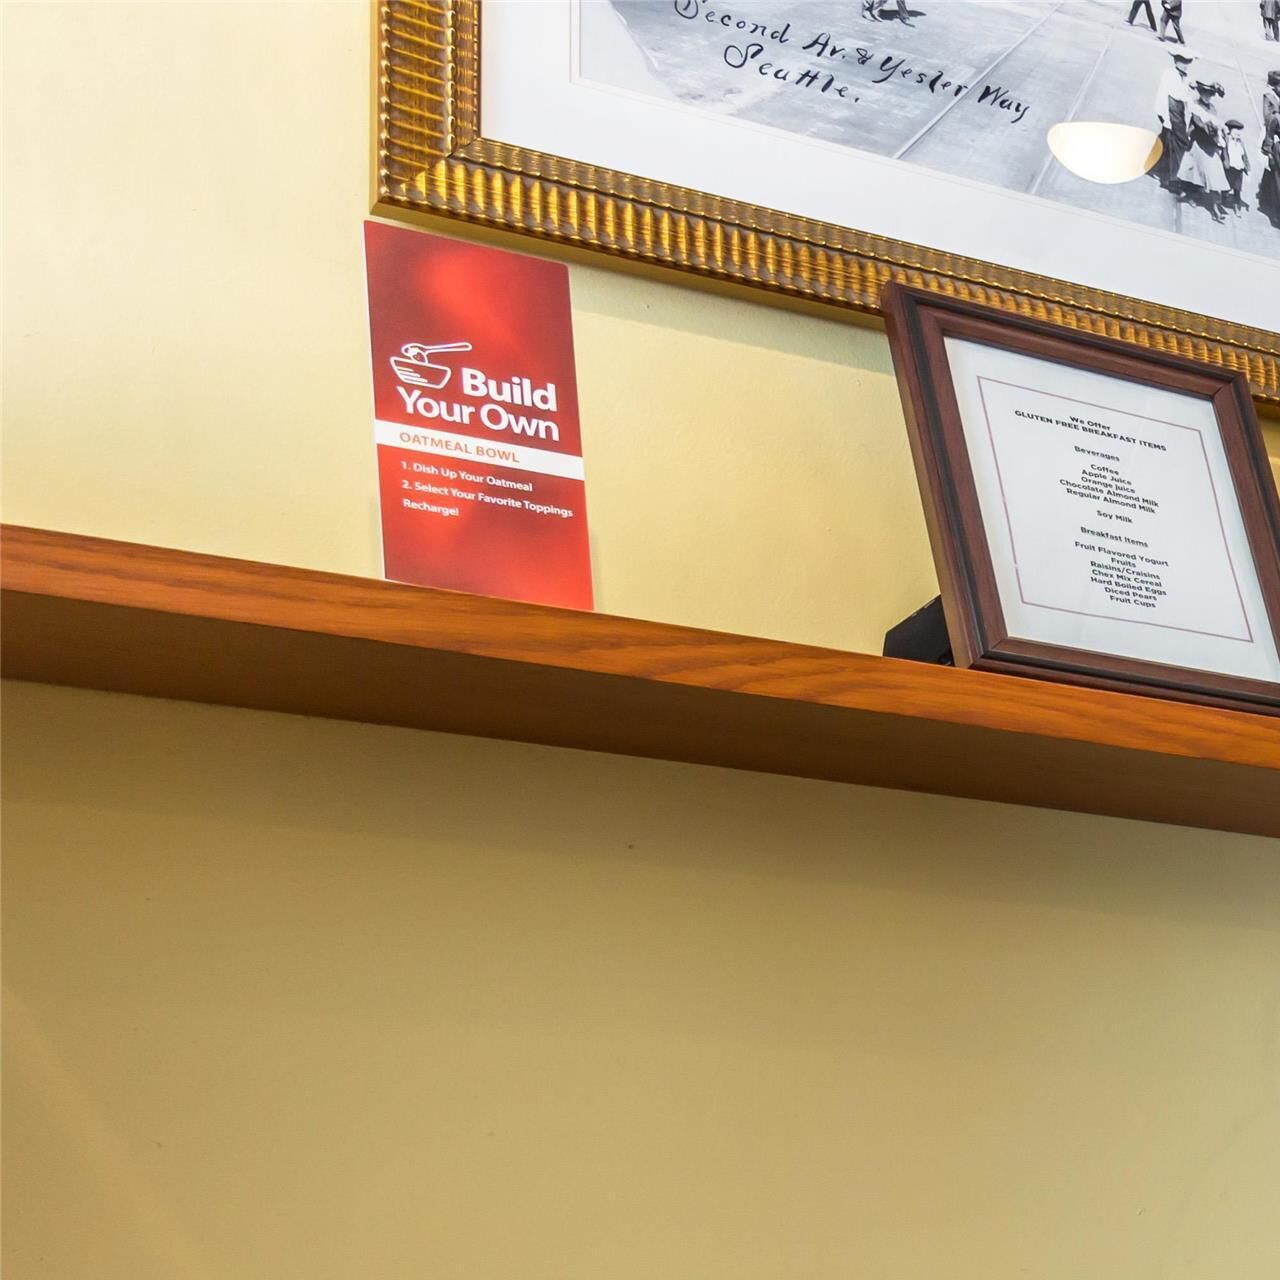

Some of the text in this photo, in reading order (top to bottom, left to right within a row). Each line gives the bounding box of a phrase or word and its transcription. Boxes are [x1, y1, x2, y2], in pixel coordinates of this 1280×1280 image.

[977, 84, 1031, 124] Way
[461, 367, 558, 412] Build
[396, 385, 560, 441] Your Own
[1069, 415, 1111, 431] We Offer
[1014, 410, 1167, 452] GLUTEN FREE BREAKFAST ITEMS
[400, 431, 520, 463] OATMEAL BOWL
[1074, 445, 1121, 462] Beverages
[401, 461, 533, 492] 1. Dish Up Your Oatmeal
[1081, 469, 1132, 486] Apple Juice
[1090, 463, 1120, 476] Coffee
[1059, 479, 1159, 508] Chocolate Almond Milk
[1081, 476, 1113, 490] Orange
[402, 480, 574, 518] 2. Select Your Favorite Toppings
[1066, 488, 1157, 514] Regular Almond Milk
[1096, 509, 1133, 523] Soy Milk
[1080, 526, 1149, 548] Breakfast Items
[1074, 541, 1169, 567] Fruit Flavored Yogurt
[1111, 557, 1137, 568] Fruits
[1090, 576, 1168, 596] Hard Boiled Eggs
[1092, 569, 1163, 587] Chex Mix Cereal
[1104, 586, 1158, 601] Diced Pears
[1109, 595, 1157, 609] Fruit Cups
